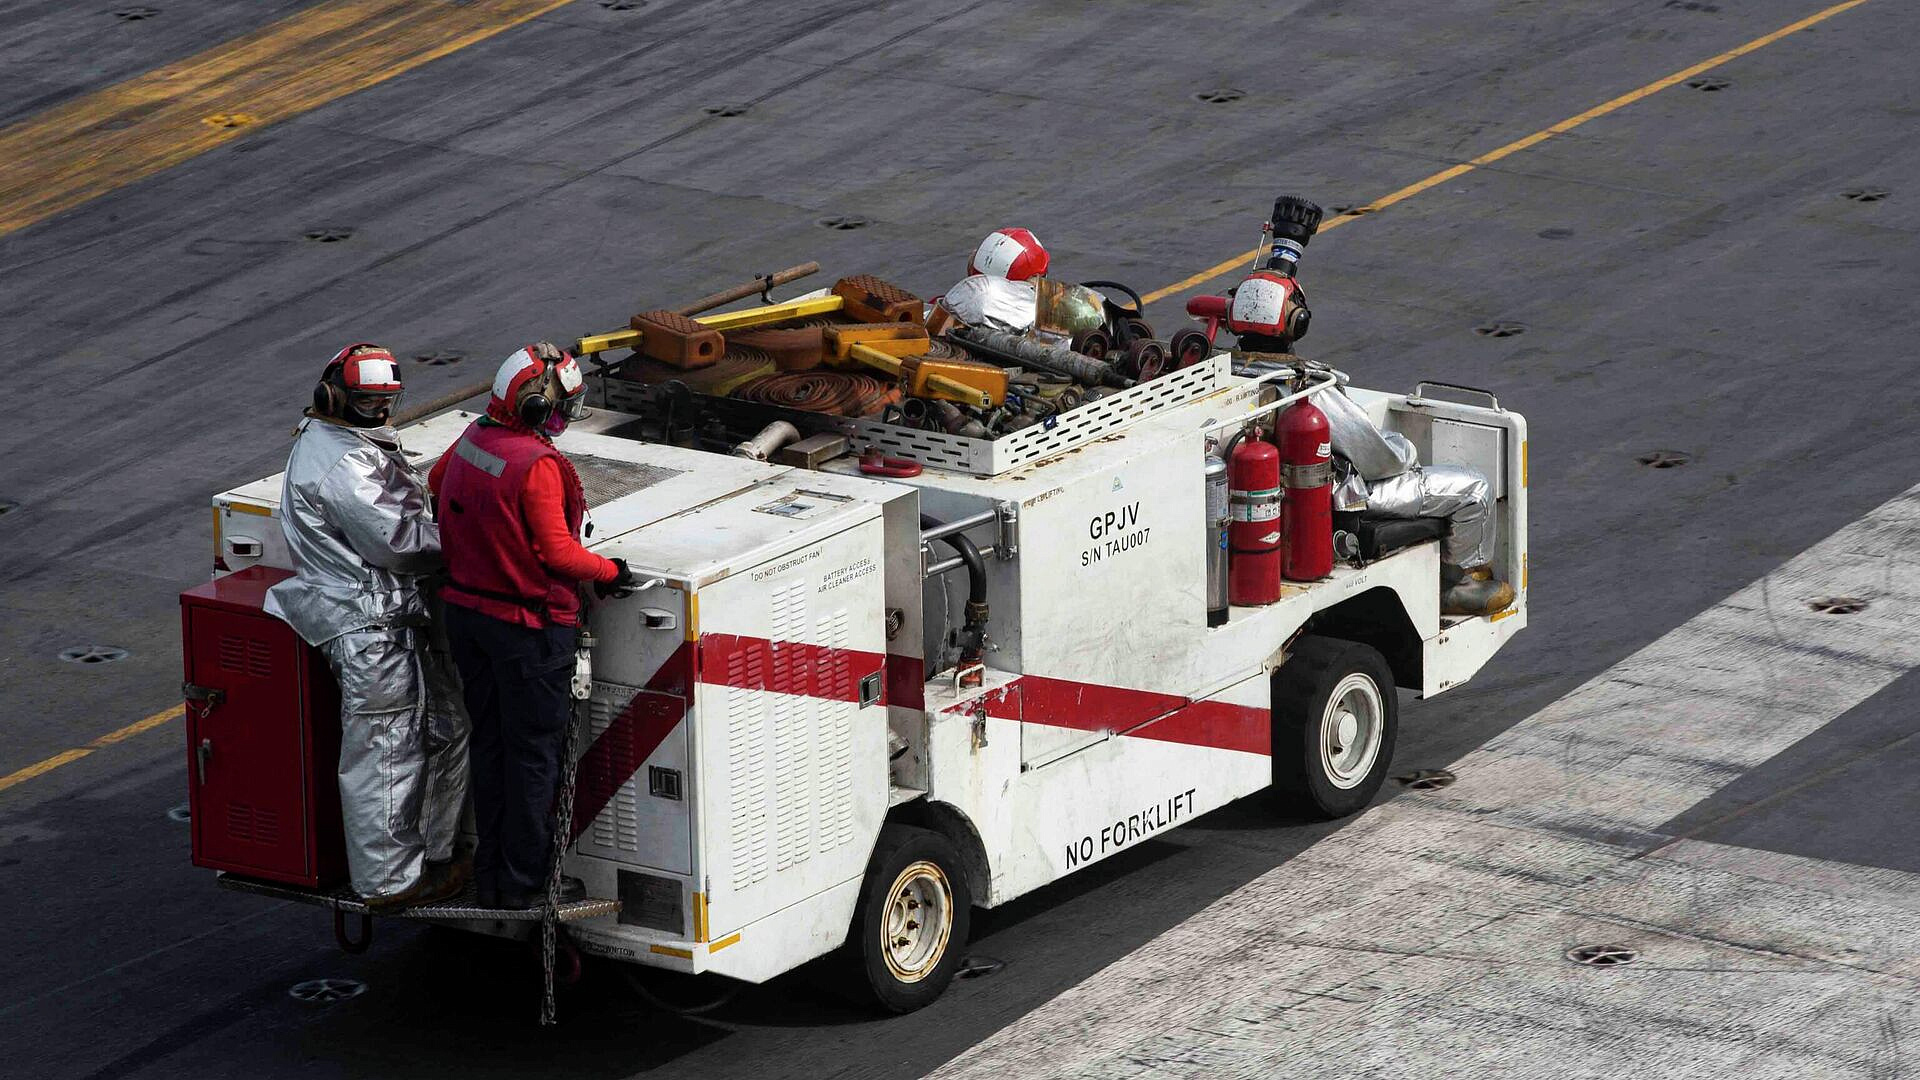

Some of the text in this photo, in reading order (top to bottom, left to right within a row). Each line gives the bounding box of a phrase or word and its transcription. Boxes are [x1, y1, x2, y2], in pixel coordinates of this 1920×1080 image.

[1089, 501, 1140, 540] GPJV
[1081, 527, 1150, 567] S/N TAU007
[753, 571, 763, 582] DO
[764, 566, 776, 578] NOT
[777, 554, 808, 574] OBSTRUCT
[817, 563, 877, 594] AIR CLEANER ACCESS
[823, 558, 871, 583] BATTERY ACCESS
[1066, 787, 1196, 869] NO FORKLIFT
